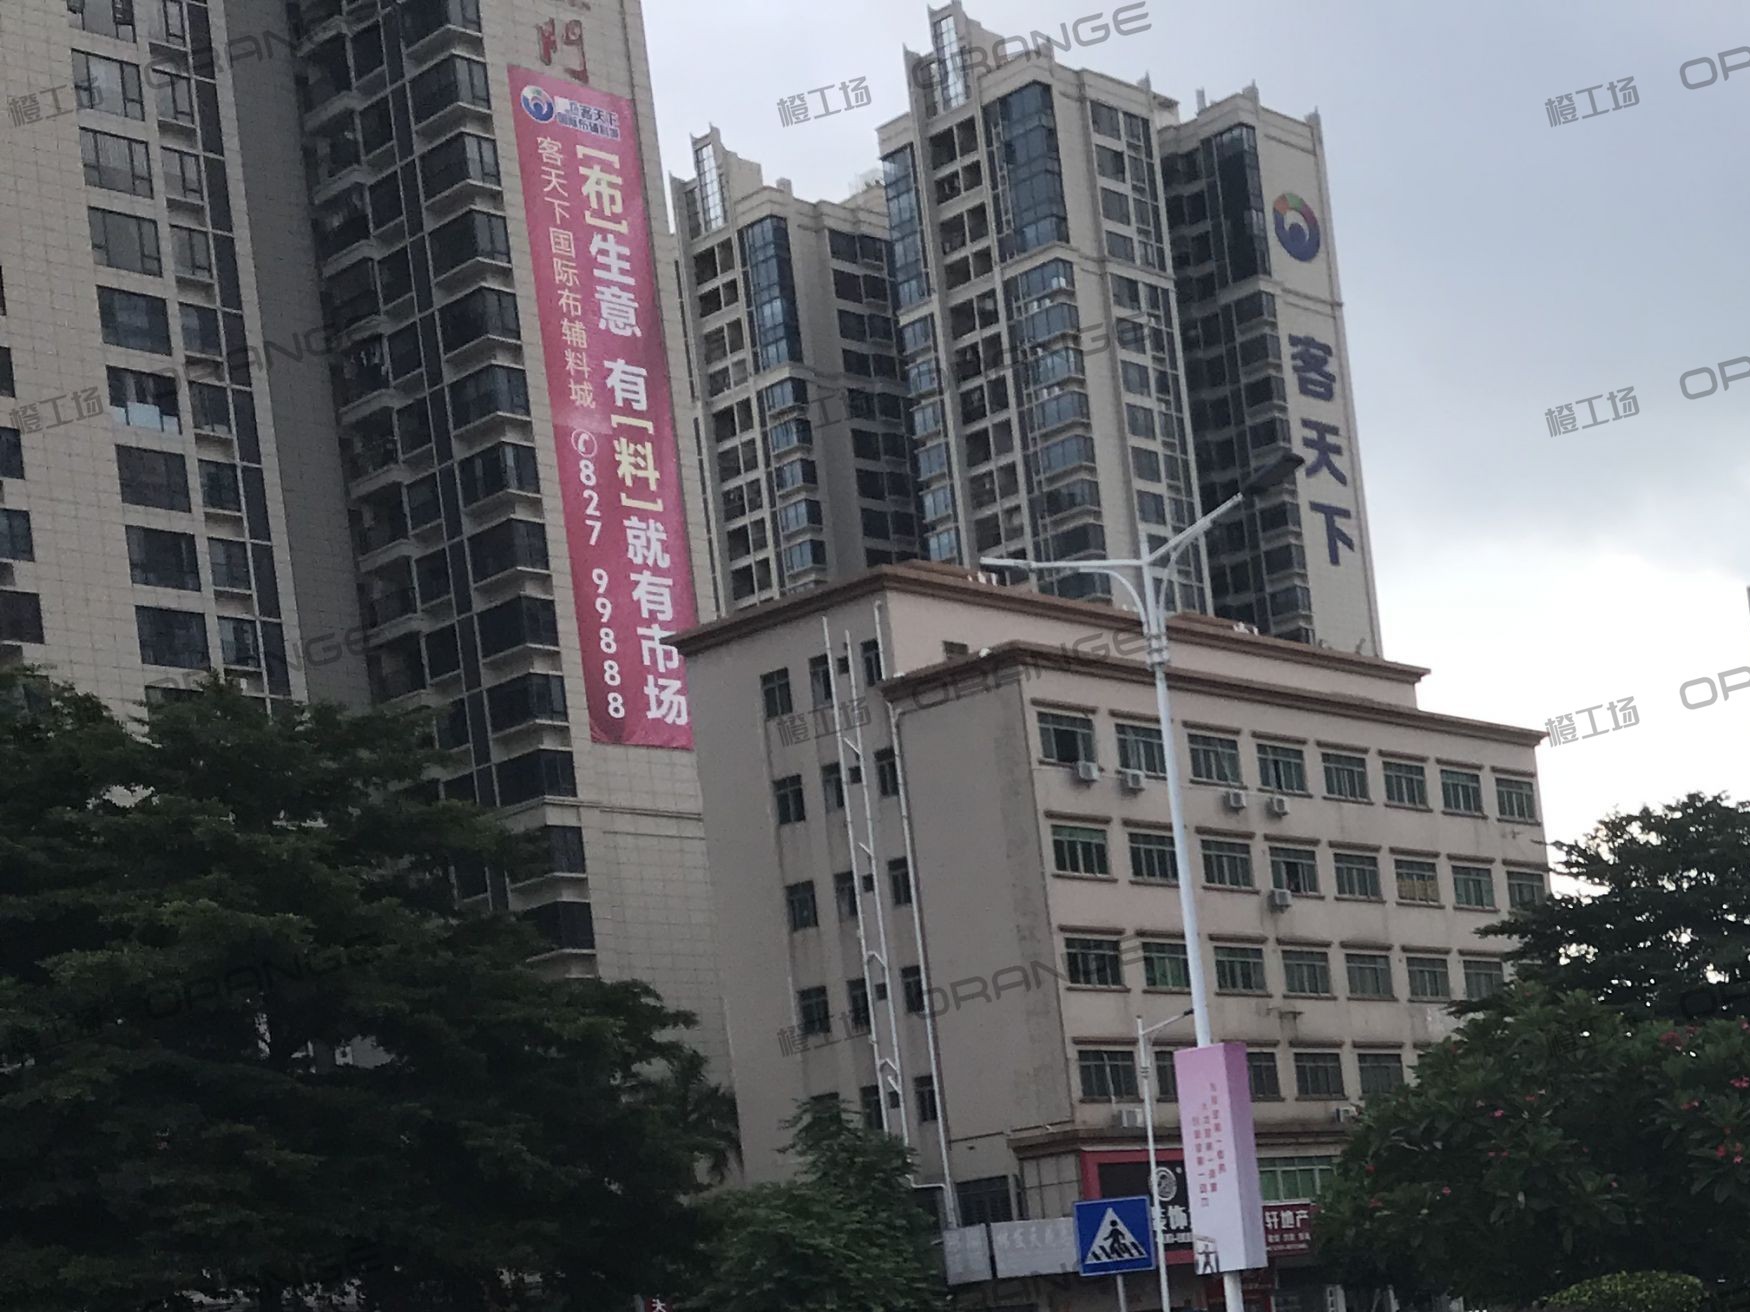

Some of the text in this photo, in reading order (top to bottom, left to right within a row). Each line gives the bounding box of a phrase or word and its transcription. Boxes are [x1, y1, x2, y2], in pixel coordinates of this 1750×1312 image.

[535, 136, 597, 411] 客天下国际布辅料城
[1288, 331, 1356, 568] 客天下
[577, 459, 626, 720] 827 99888
